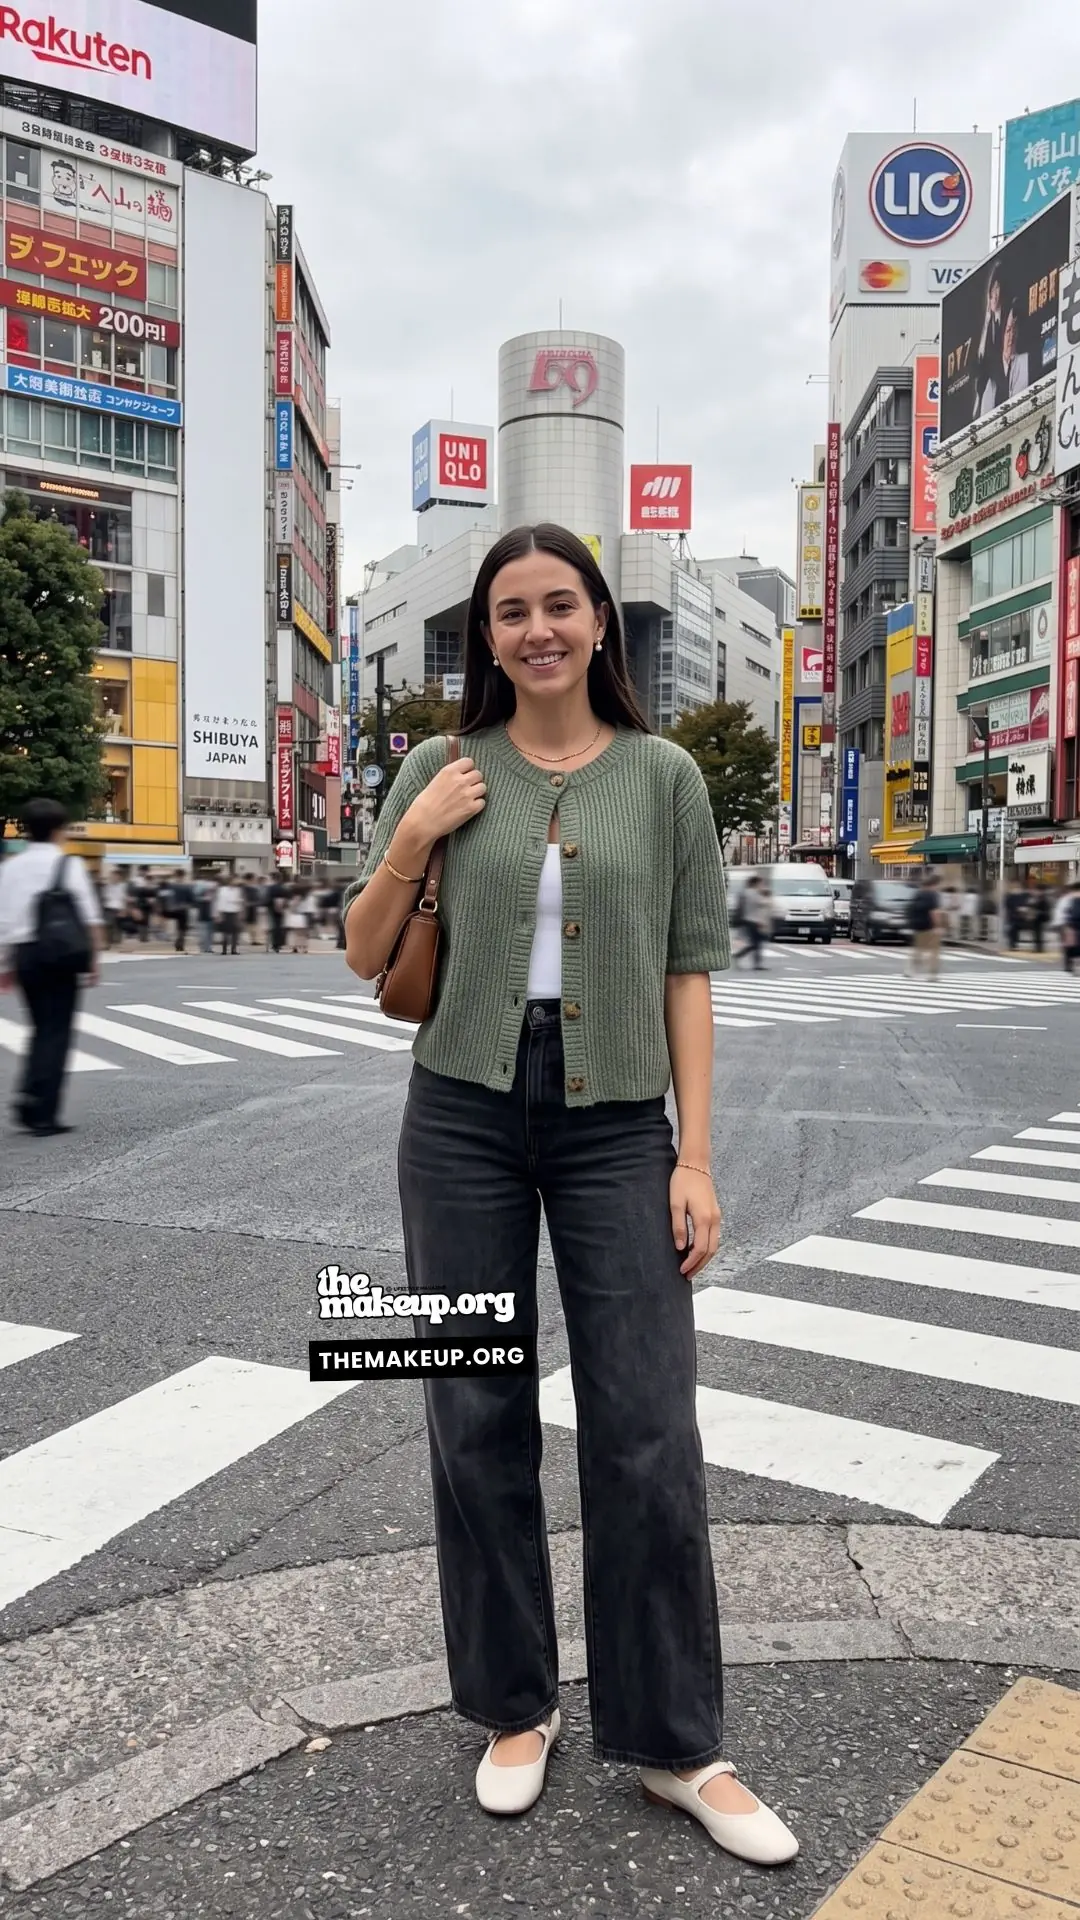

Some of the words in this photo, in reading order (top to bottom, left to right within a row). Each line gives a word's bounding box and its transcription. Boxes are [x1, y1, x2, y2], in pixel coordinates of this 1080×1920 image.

[0, 5, 152, 80] Rakuten
[932, 268, 971, 284] VIS
[99, 307, 166, 341] 200円!
[445, 441, 478, 461] UNI
[445, 461, 481, 482] QLO
[193, 730, 259, 748] SHIBUYA
[205, 752, 247, 765] JAPAN
